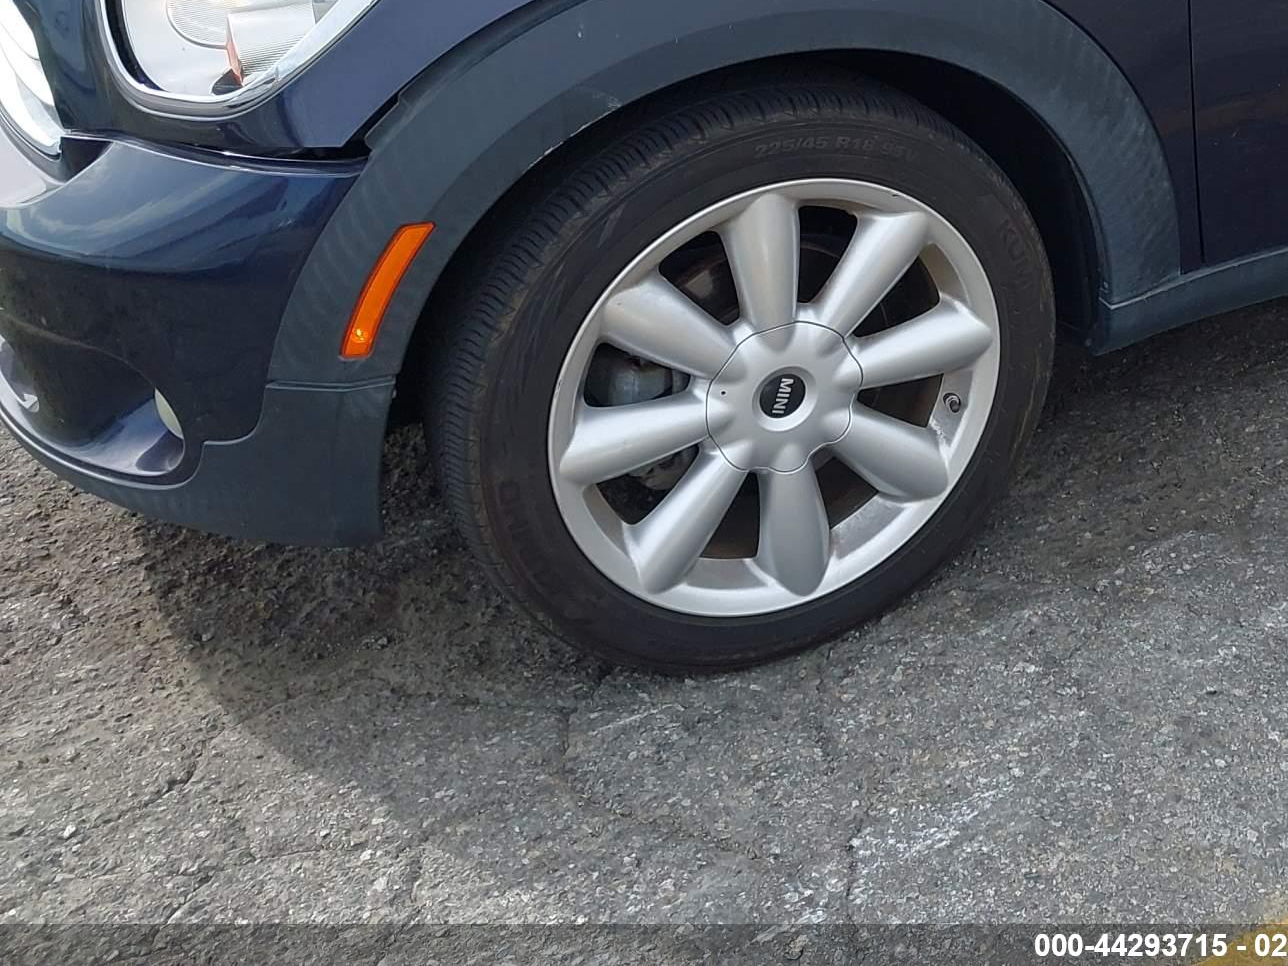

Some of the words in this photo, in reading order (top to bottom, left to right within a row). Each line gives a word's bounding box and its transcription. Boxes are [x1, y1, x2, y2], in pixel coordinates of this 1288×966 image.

[753, 136, 831, 160] 225/45
[834, 135, 875, 151] R18
[771, 377, 795, 415] MINI
